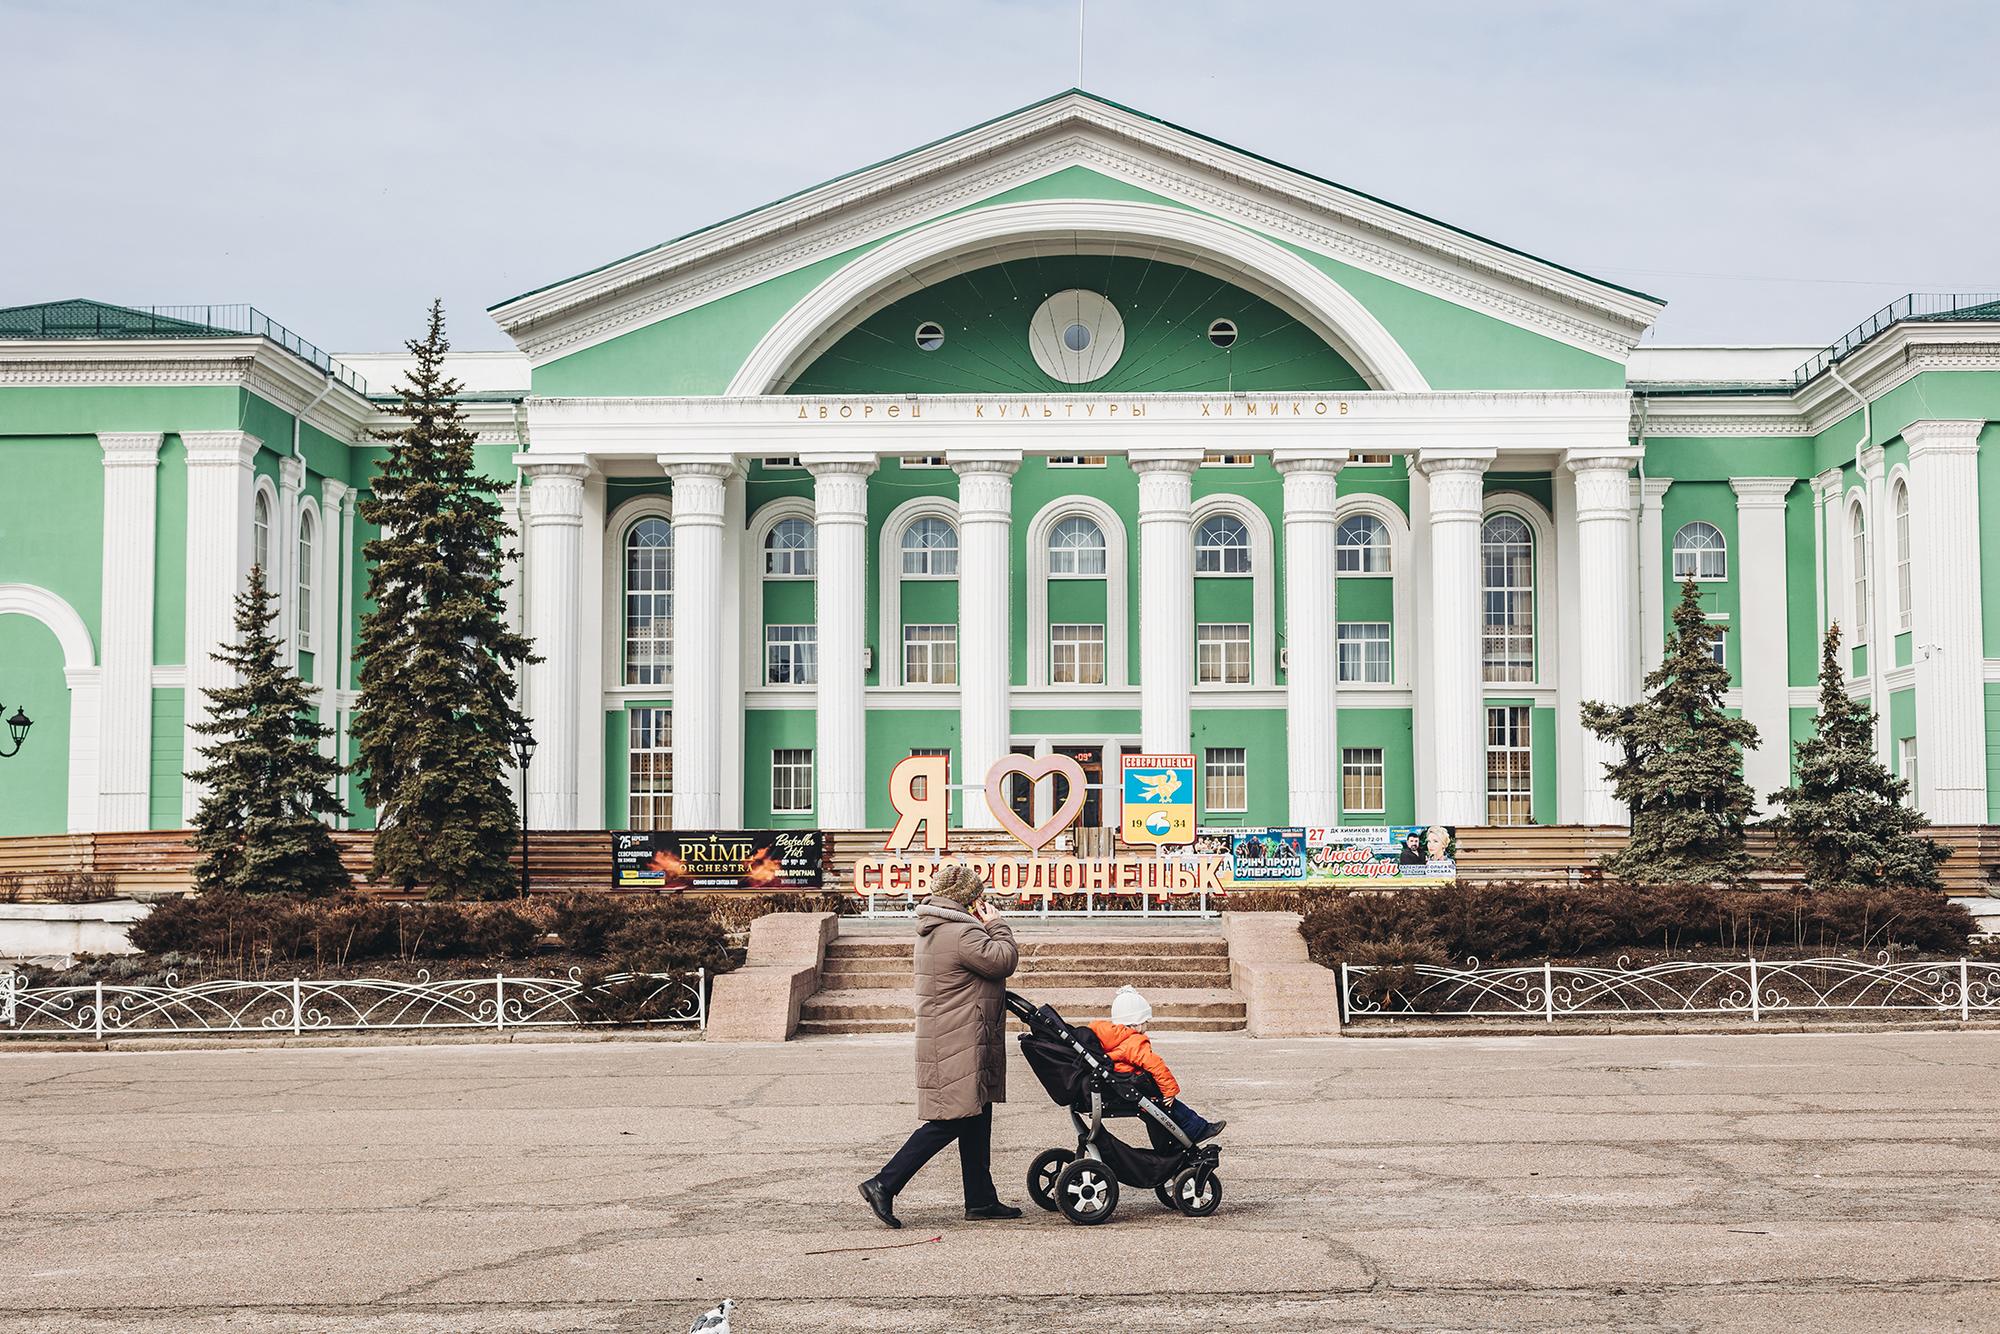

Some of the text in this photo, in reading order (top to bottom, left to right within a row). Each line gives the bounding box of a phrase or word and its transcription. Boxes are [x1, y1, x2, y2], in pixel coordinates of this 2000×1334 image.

[976, 404, 1146, 418] КУЛЬТУРЫ
[1201, 402, 1349, 417] ХИМИКОВ
[885, 756, 949, 850] Я
[1131, 819, 1186, 829] 19 34
[775, 833, 815, 847] Bestseller
[1308, 828, 1325, 841] 27
[619, 835, 631, 849] 25
[679, 843, 753, 861] PRIME
[784, 846, 804, 859] Hits
[1315, 846, 1371, 863] Любов
[680, 864, 752, 872] ORCHESTRA
[1236, 857, 1265, 868] ГРІНЧ
[1266, 857, 1301, 868] ПРОТИ
[1344, 858, 1397, 878] голуби
[1235, 867, 1302, 878] СУПЕРГЕРОЇВ
